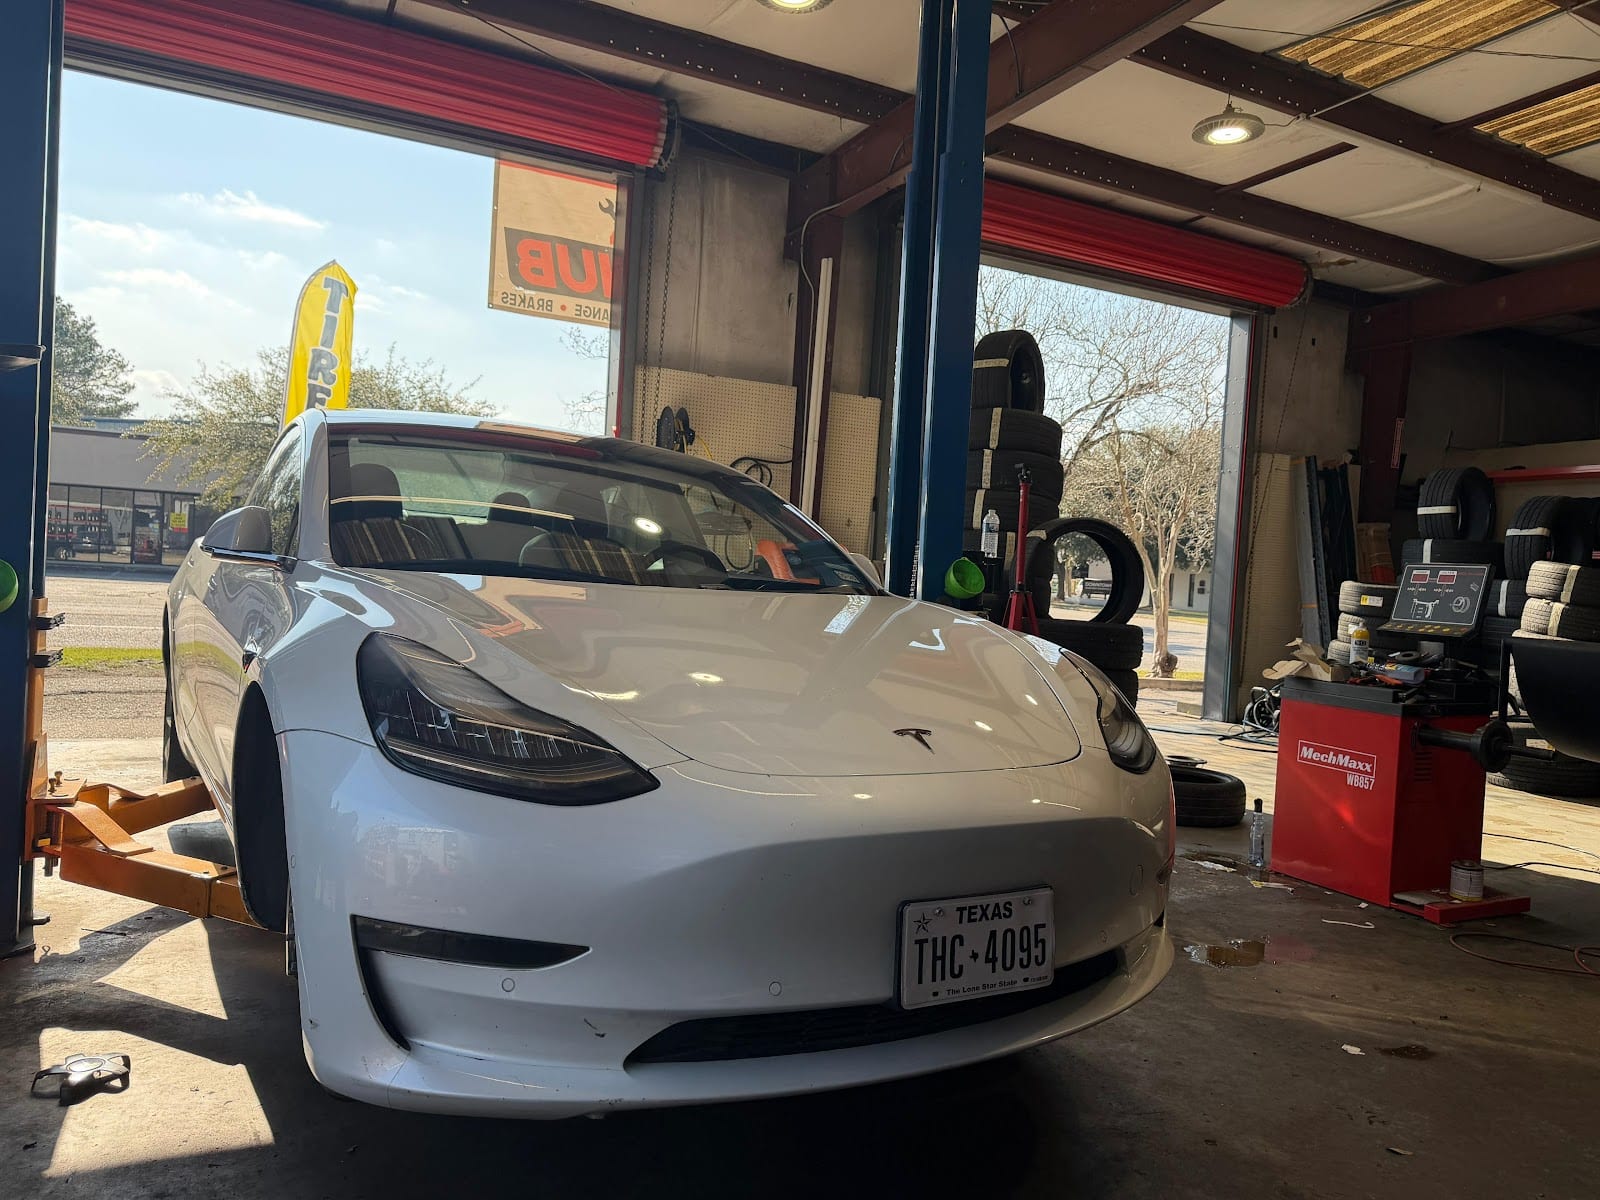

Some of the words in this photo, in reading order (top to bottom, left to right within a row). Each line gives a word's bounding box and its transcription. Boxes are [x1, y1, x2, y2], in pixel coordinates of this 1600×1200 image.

[1300, 746, 1372, 772] MechMaxx
[1346, 773, 1375, 791] WB857
[956, 901, 1013, 925] TEXAS
[914, 934, 965, 985] THC
[984, 923, 1047, 974] 4095
[962, 985, 980, 993] Lone
[982, 982, 997, 991] Star
[998, 979, 1018, 988] State
